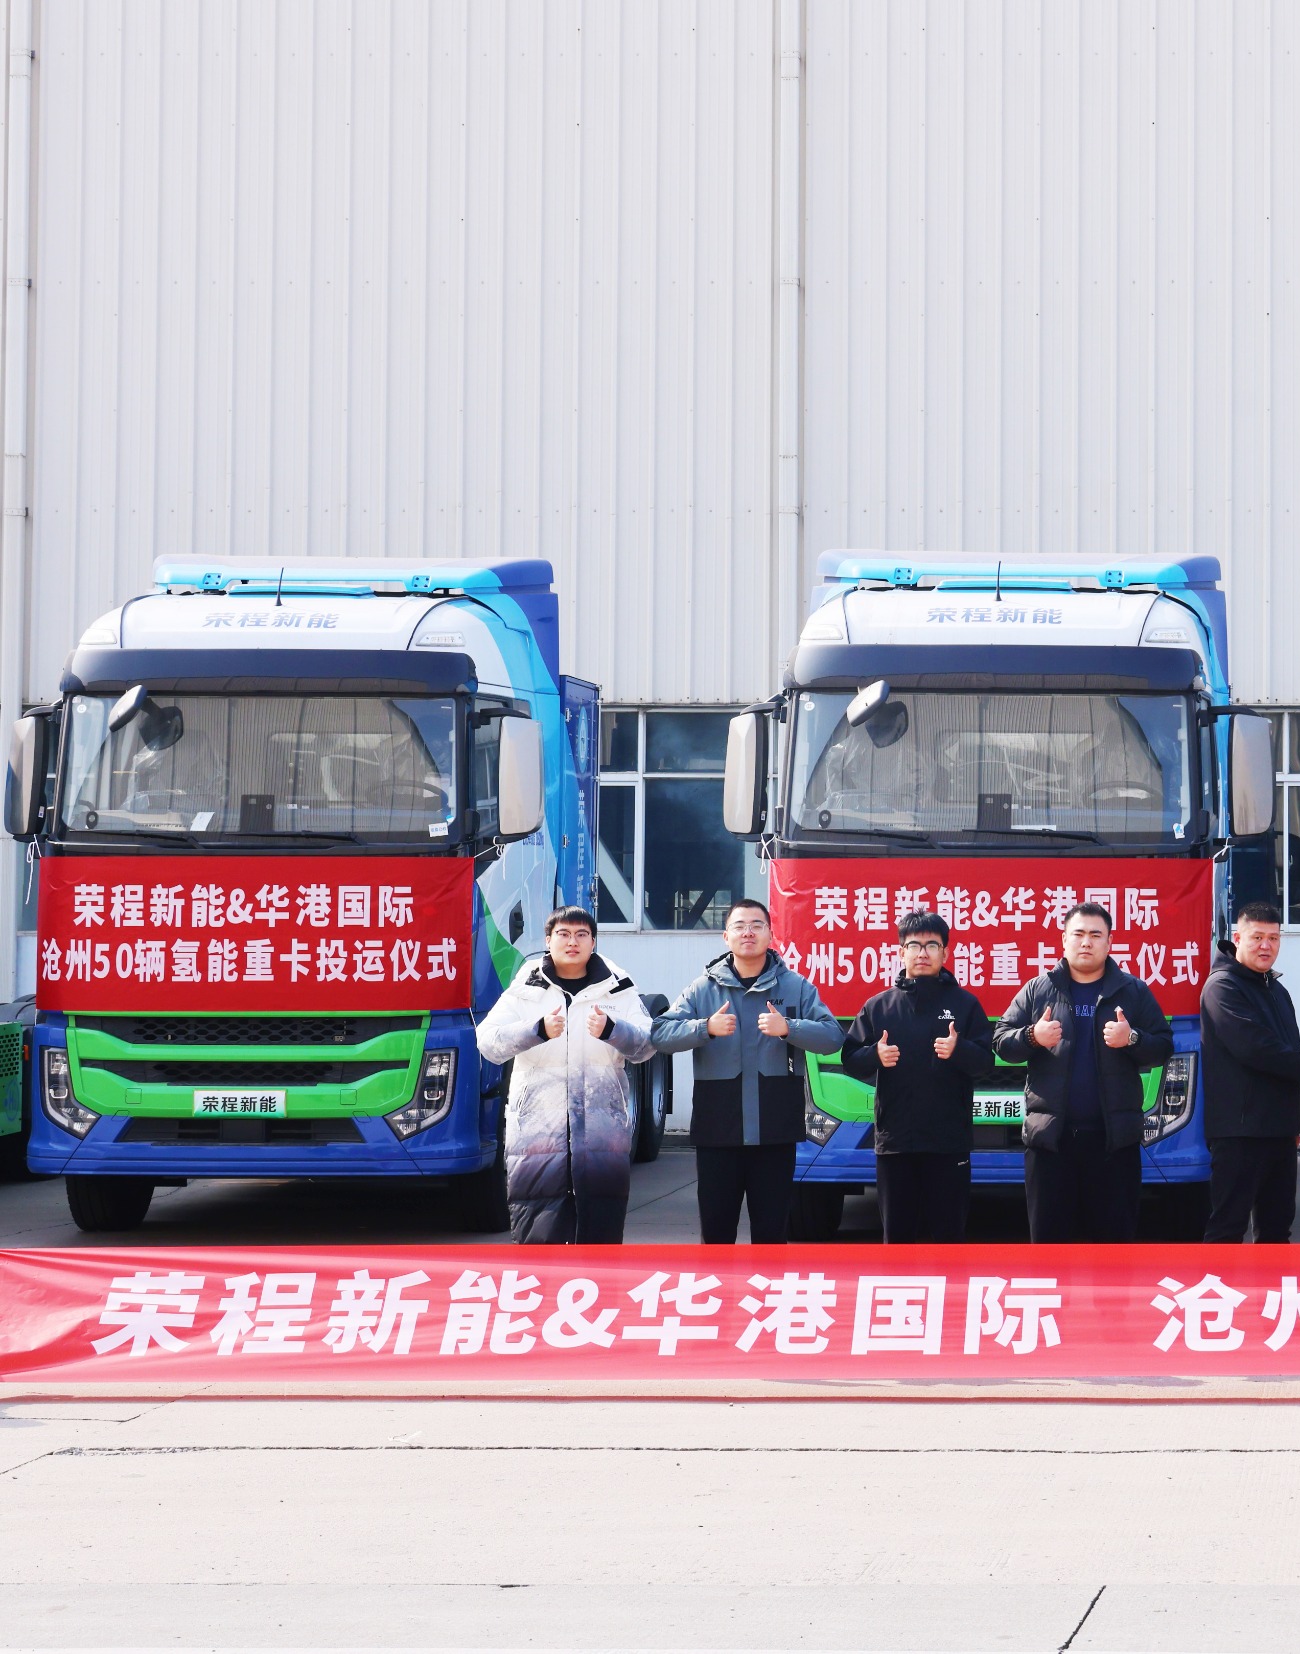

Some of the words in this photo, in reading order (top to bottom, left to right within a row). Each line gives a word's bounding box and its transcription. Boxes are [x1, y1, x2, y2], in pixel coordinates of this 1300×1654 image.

[201, 612, 340, 629] 荣程新能
[926, 607, 1063, 625] 荣程新能
[74, 884, 414, 928] 荣程新能&华港国际
[41, 937, 457, 983] 沧州50辆氢能重卡投运仪式
[202, 1096, 277, 1113] 荣程新能
[972, 1100, 1021, 1118] 程新能
[92, 1268, 1063, 1357] 荣程新能&华港国际
